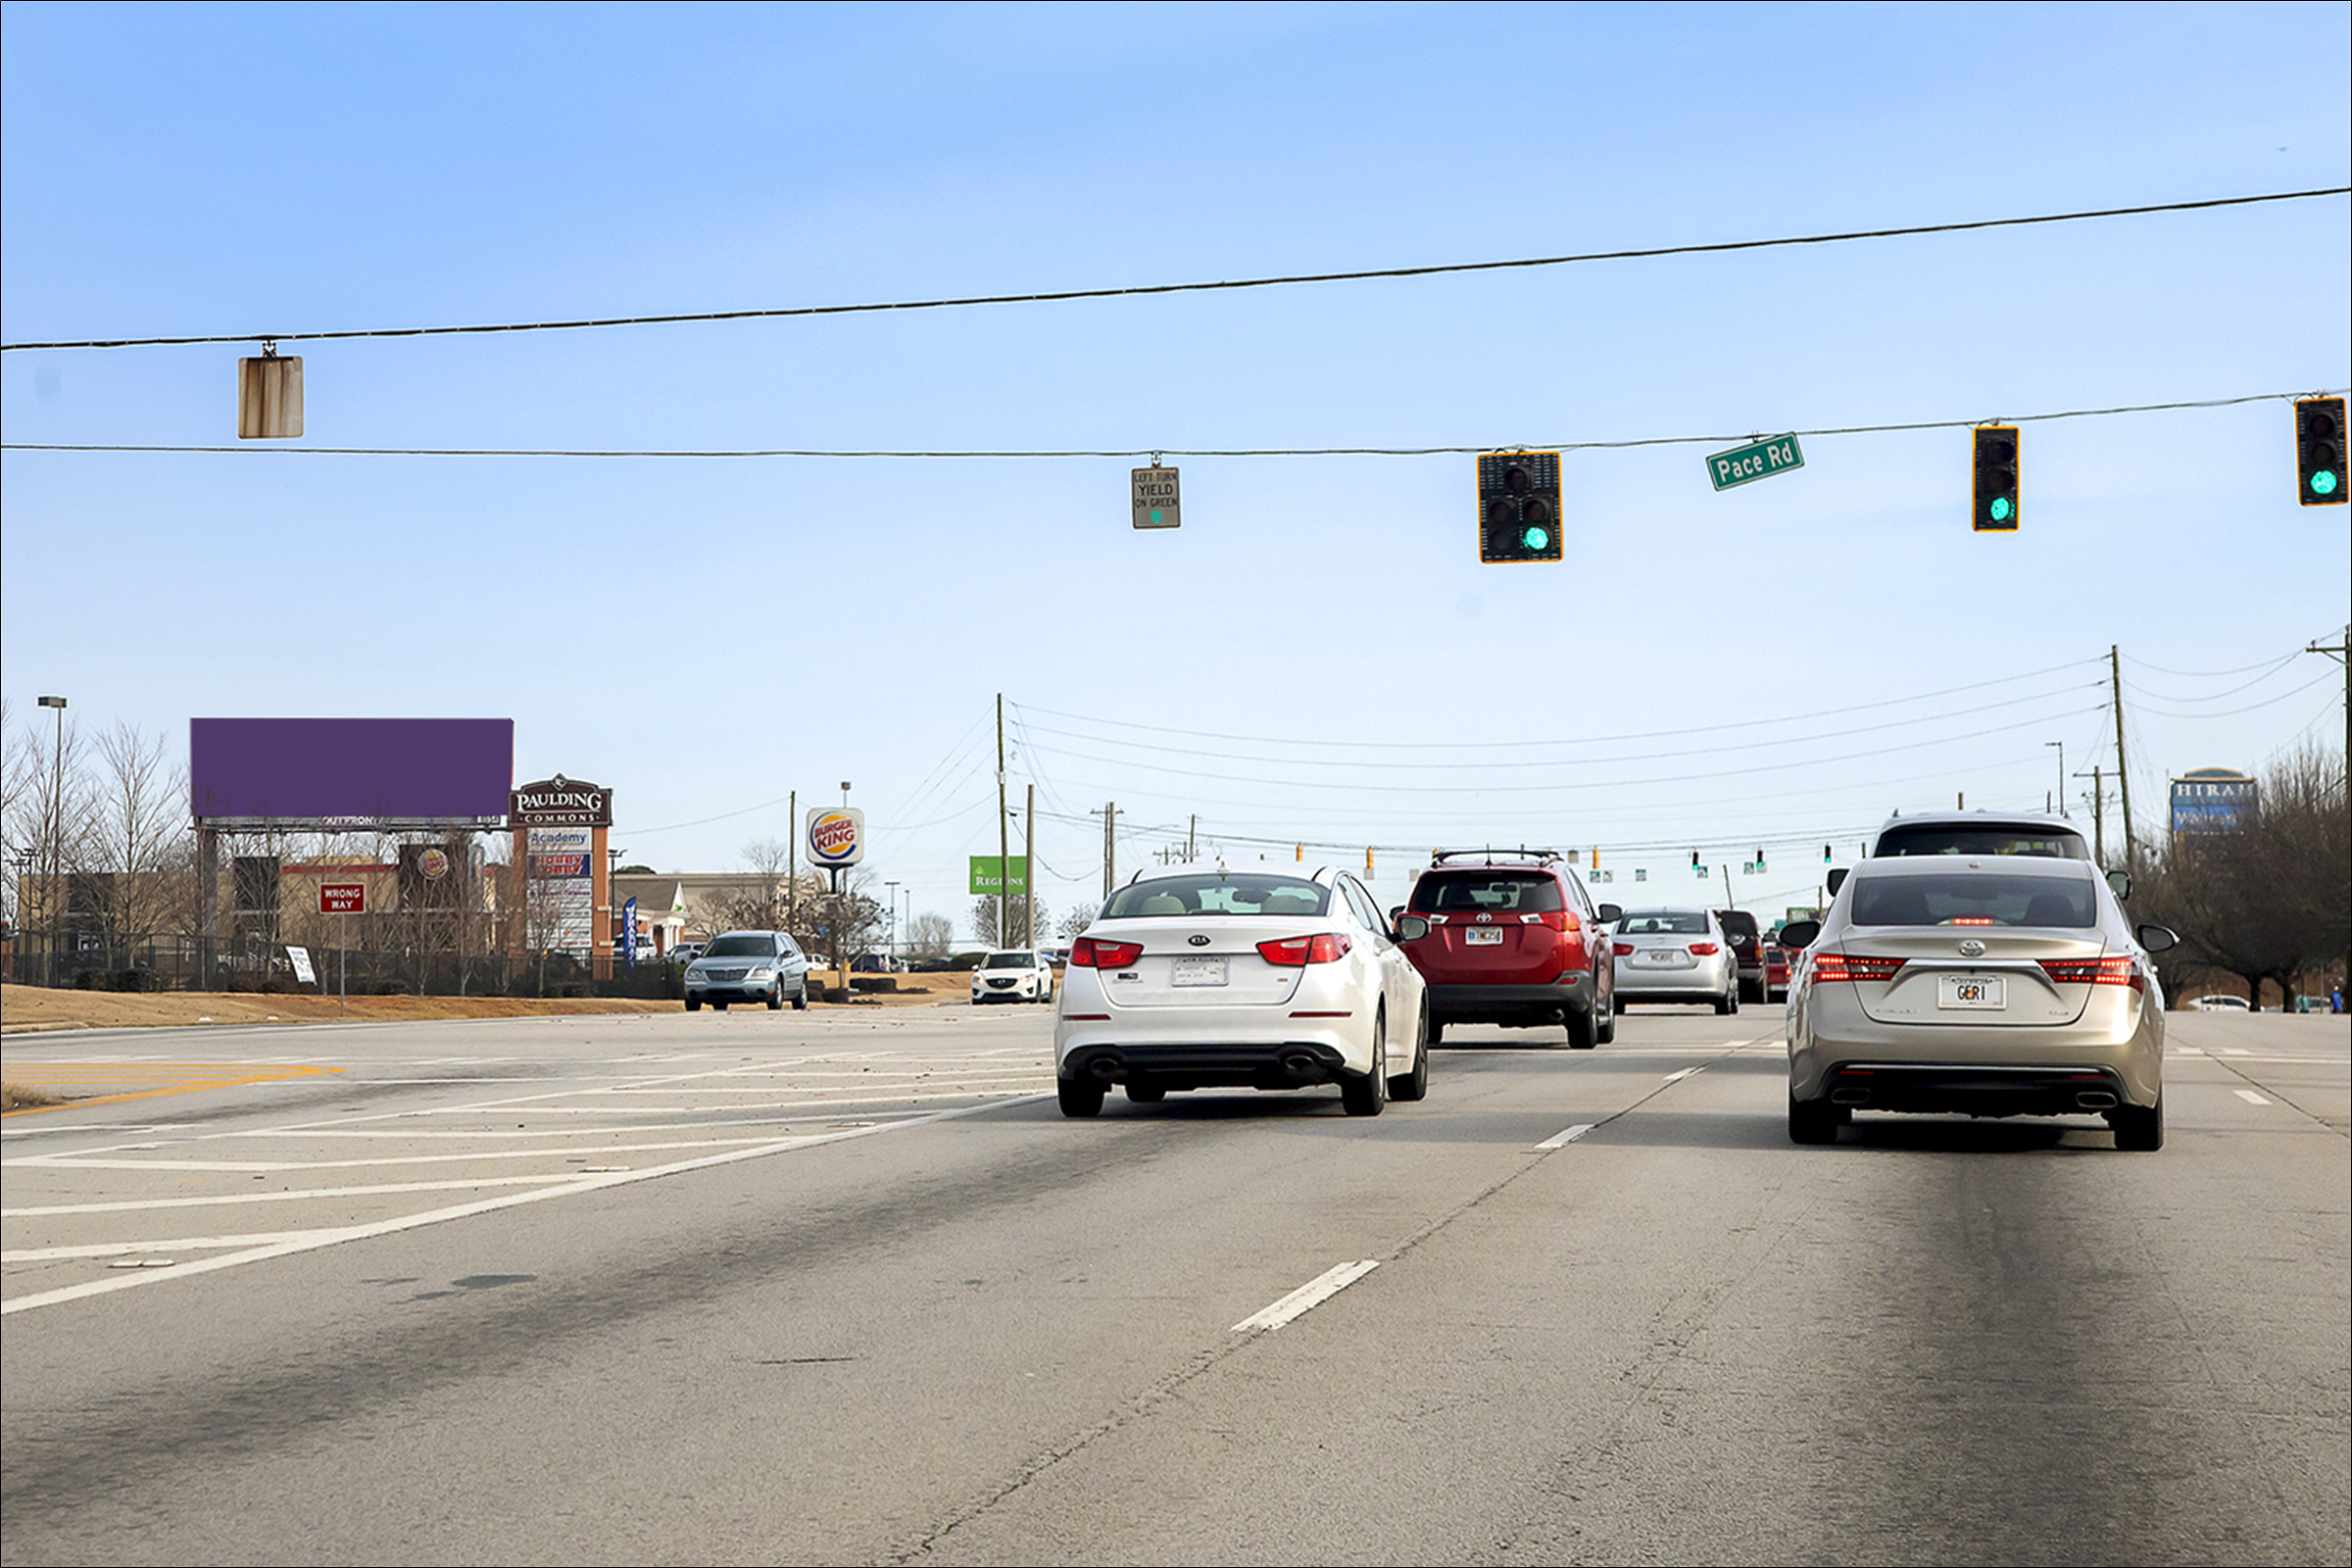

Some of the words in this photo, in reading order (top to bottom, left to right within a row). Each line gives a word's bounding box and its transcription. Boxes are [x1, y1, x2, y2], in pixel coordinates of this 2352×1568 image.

[1717, 455, 1763, 482] Pace
[1767, 441, 1793, 468] Rd
[1134, 472, 1153, 483] LEFT
[1138, 483, 1174, 496] YIELD
[1135, 498, 1148, 508] ON
[1150, 497, 1178, 508] GREEN
[2178, 784, 2253, 796] HIRAM
[516, 792, 603, 812] PAULDING
[524, 813, 595, 823] COMMONS
[814, 819, 854, 839] BURGER
[531, 832, 587, 846] Academy
[816, 828, 856, 851] KING
[975, 876, 1024, 886] REGINS
[324, 888, 361, 899] WRONG
[330, 901, 354, 909] WAY
[1957, 985, 1985, 1001] GERI
